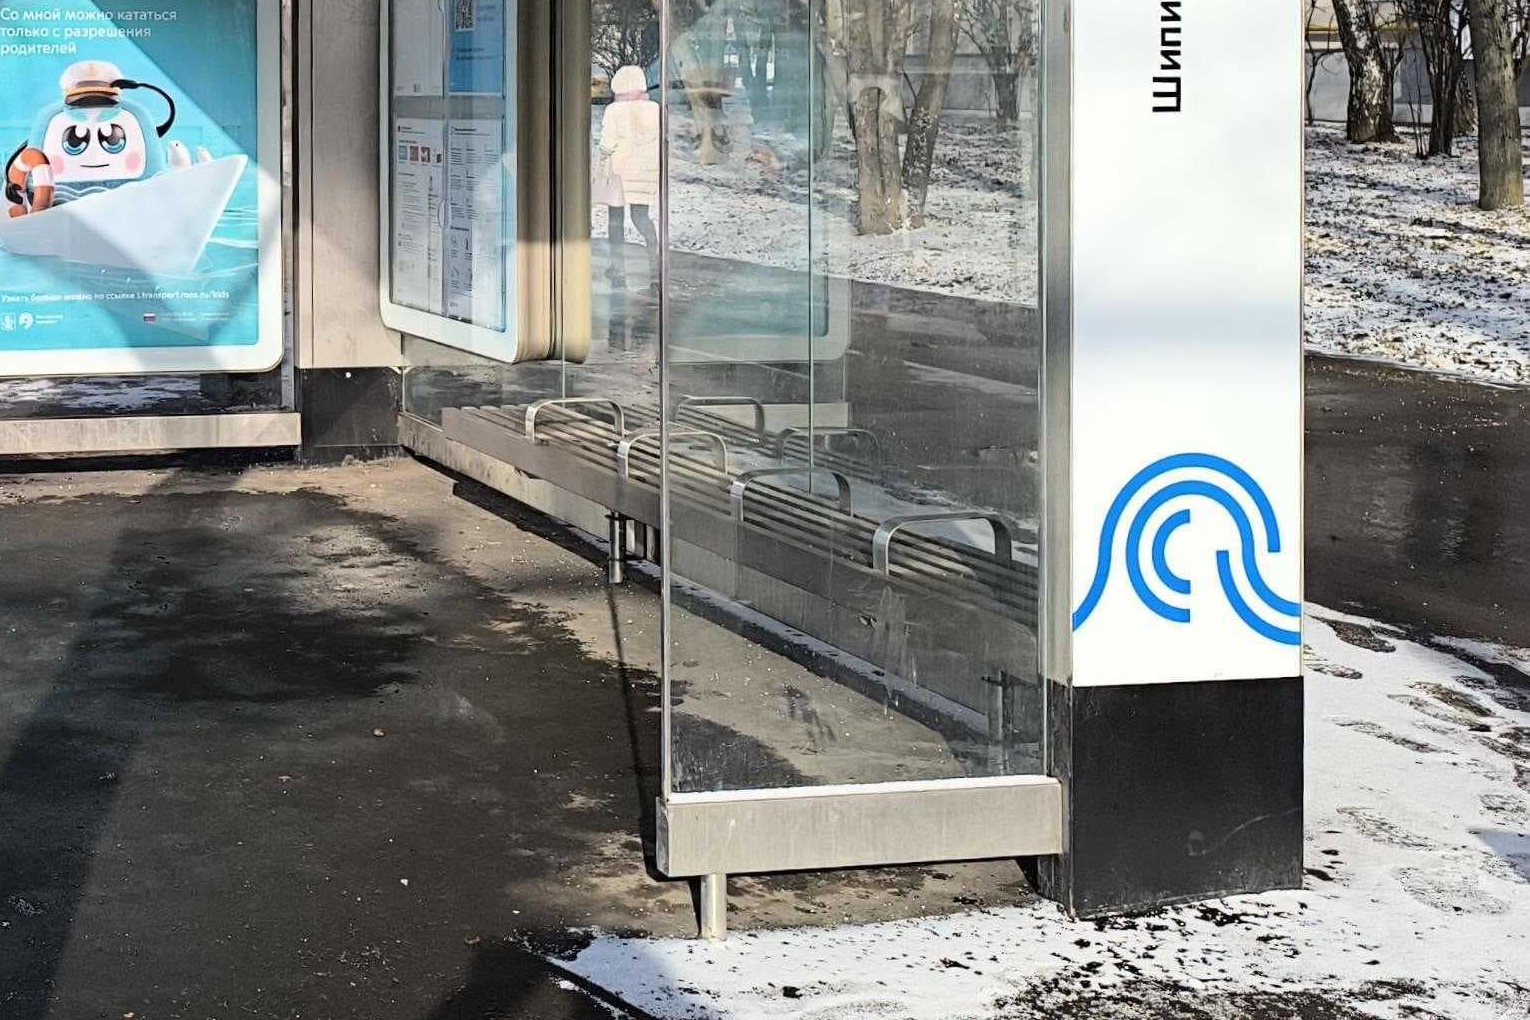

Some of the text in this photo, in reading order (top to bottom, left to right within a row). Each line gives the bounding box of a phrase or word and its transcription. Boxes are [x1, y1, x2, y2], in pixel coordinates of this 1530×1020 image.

[0, 7, 178, 21] Со мной можно кататься
[0, 26, 152, 40] только с разрешения
[0, 41, 77, 57] родителей
